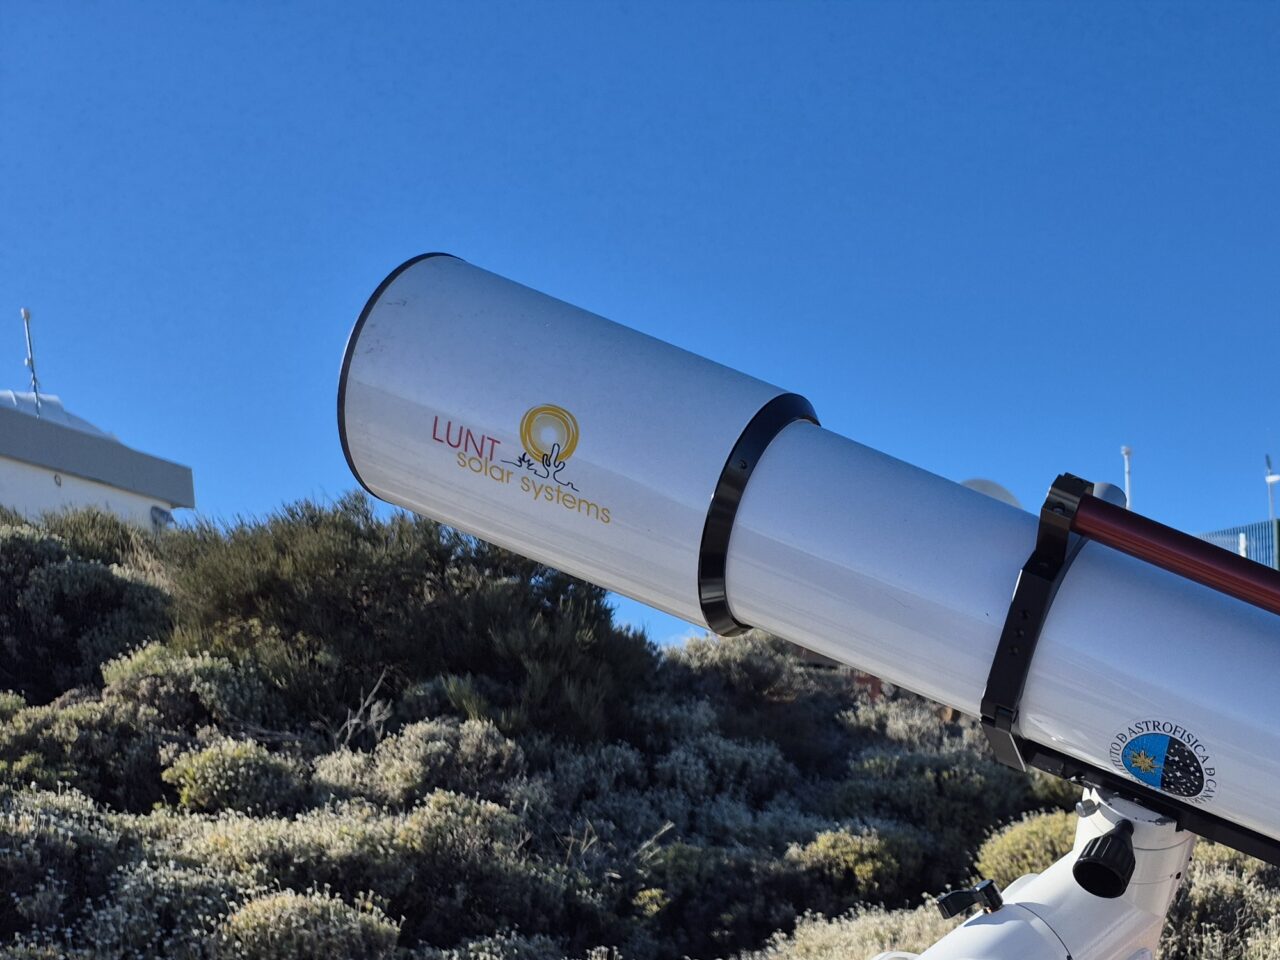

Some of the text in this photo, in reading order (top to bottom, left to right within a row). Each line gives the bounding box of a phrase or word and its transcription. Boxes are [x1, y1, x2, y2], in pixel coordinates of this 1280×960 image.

[432, 415, 501, 462] LUNT
[456, 451, 611, 524] solar systems
[1127, 720, 1210, 764] ASTROFISICA
